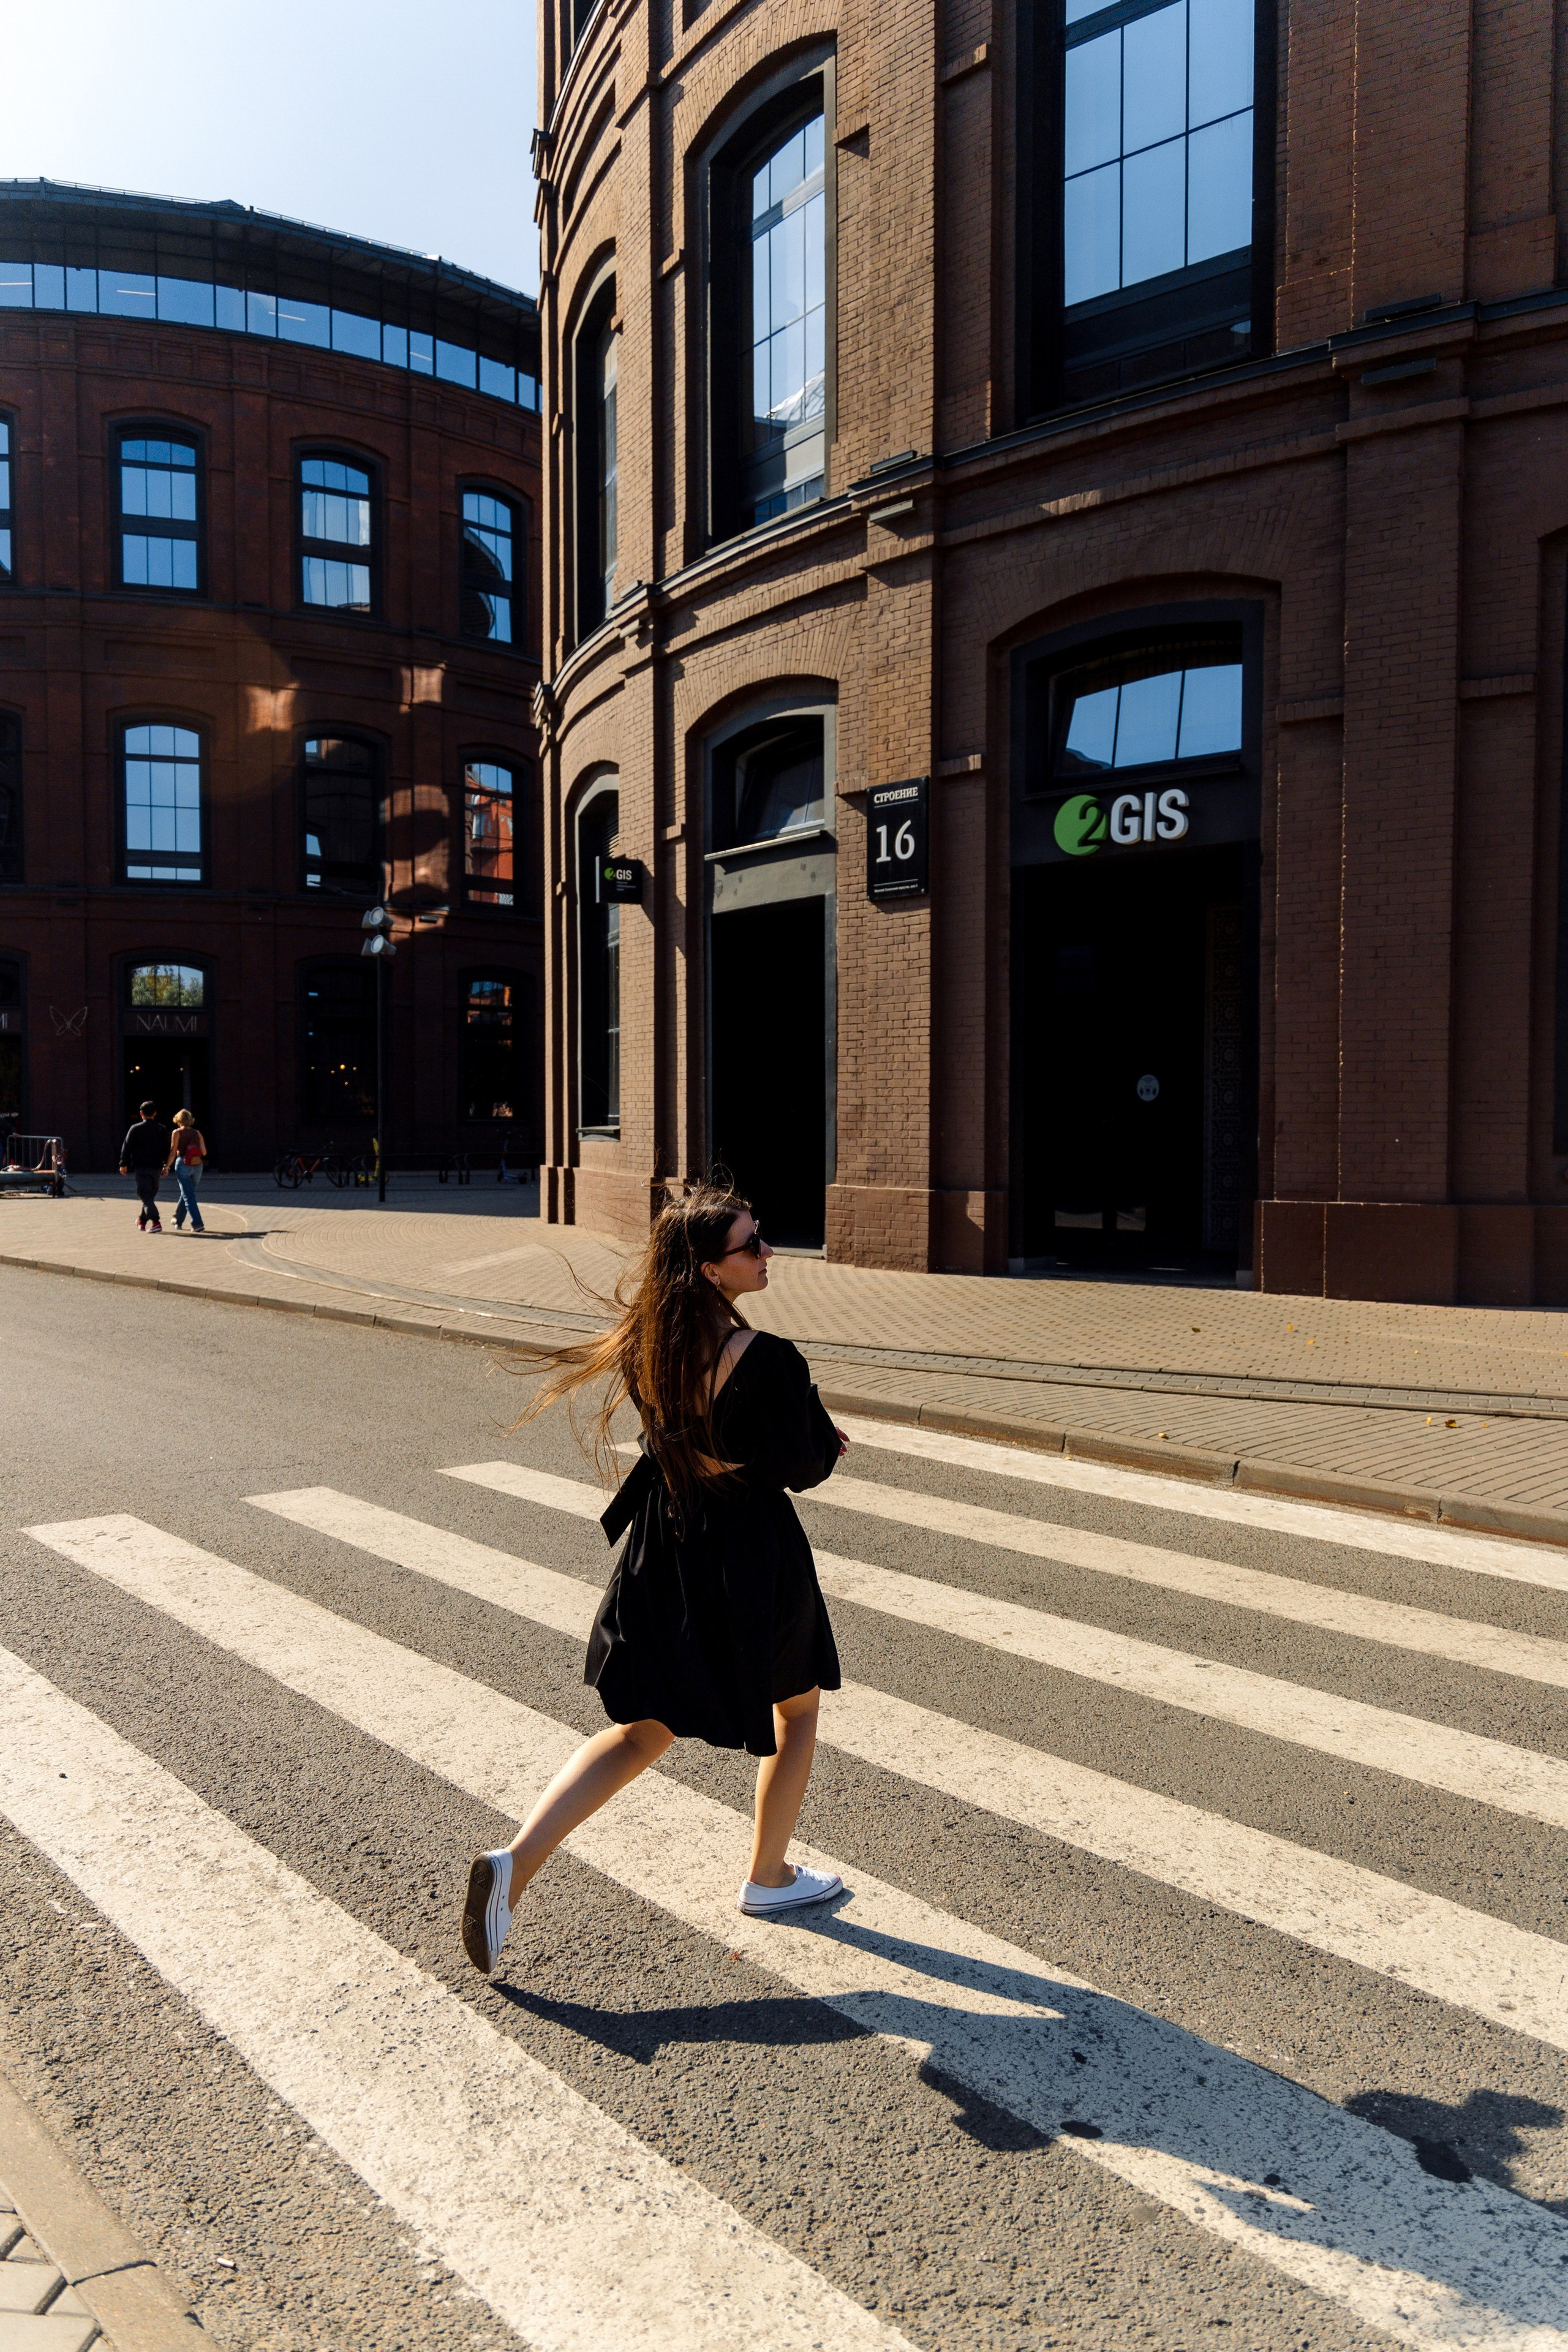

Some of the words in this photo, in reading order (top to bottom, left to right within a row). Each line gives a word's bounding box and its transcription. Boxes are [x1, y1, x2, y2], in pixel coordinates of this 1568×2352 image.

[874, 786, 918, 804] СТРОЕНИЕ
[1054, 788, 1189, 856] 2GIS
[876, 820, 915, 863] 16
[604, 867, 632, 880] 2GIS
